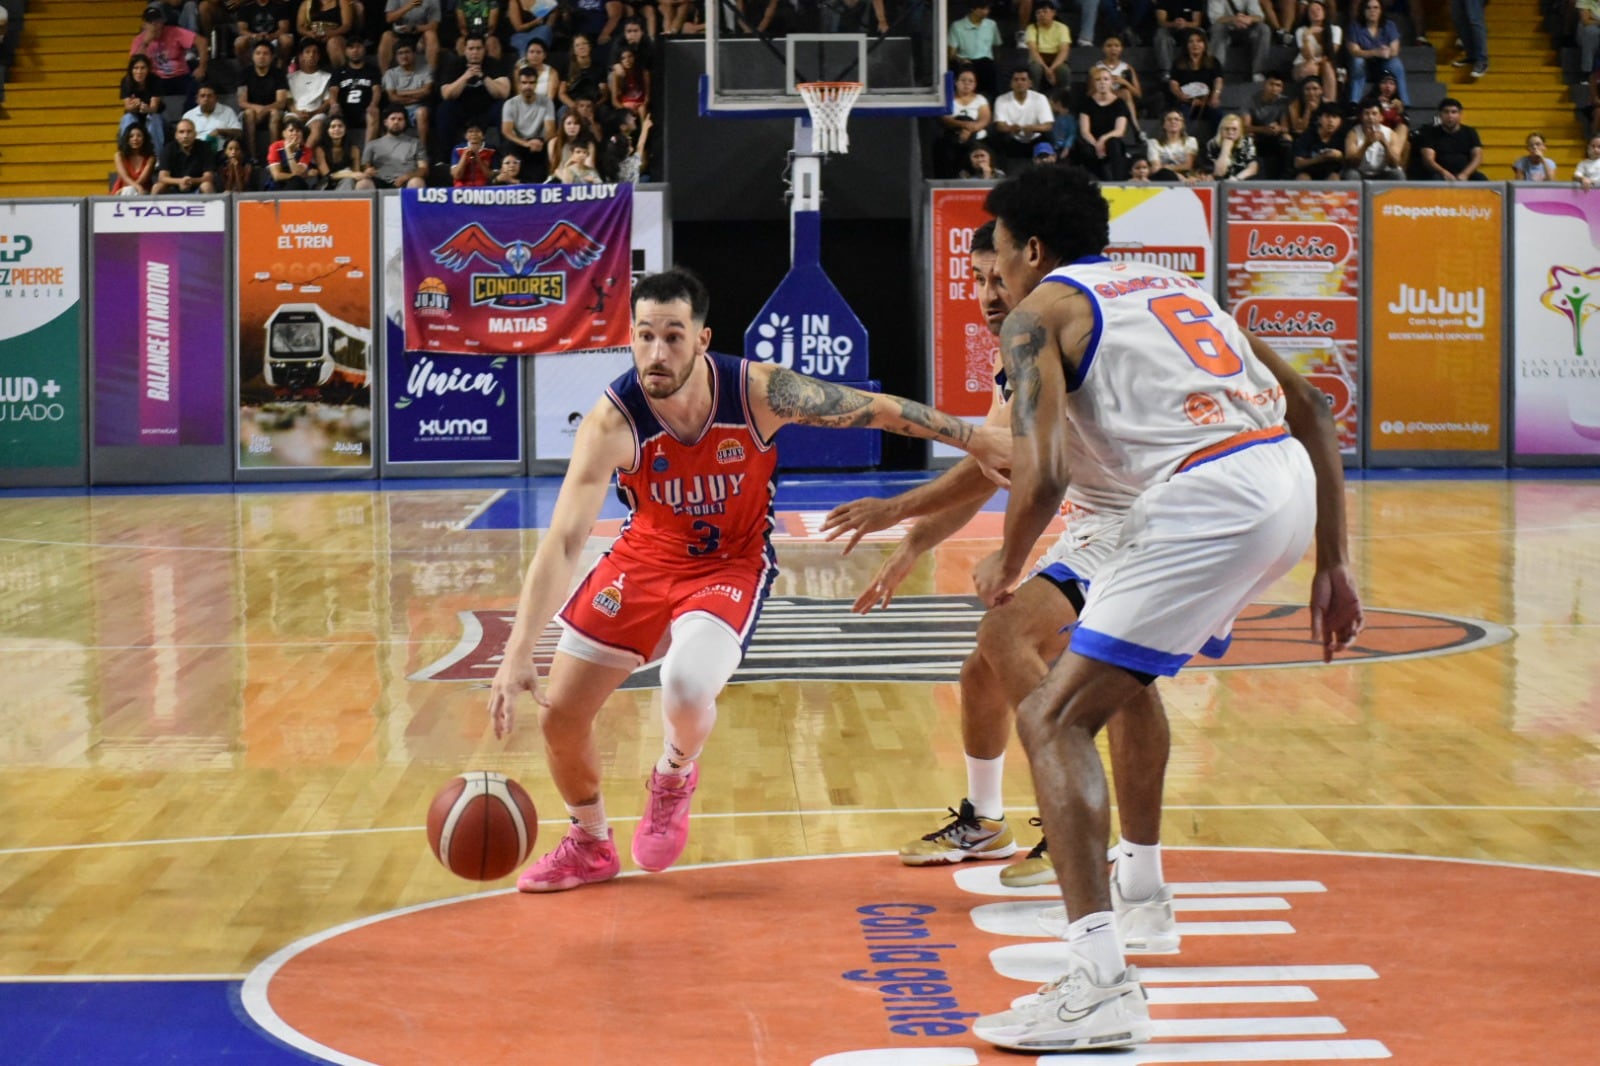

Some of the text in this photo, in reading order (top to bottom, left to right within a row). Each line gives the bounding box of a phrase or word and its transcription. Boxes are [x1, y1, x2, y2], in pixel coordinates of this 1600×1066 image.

[347, 89, 362, 103] 2
[418, 184, 618, 205] LOS CONDORES DE JUJUY
[129, 206, 205, 217] TADE
[1382, 205, 1492, 220] #DeportesJujuy
[281, 221, 328, 234] vuelve
[277, 235, 333, 249] EL TREN
[1248, 229, 1336, 259] Luisiño
[950, 257, 970, 279] DE
[147, 261, 170, 320] MOTION
[475, 276, 561, 298] CONDORES
[950, 282, 966, 300] DE
[415, 294, 449, 309] JUJUY
[147, 319, 170, 338] IN
[489, 317, 547, 333] MATIAS
[801, 314, 829, 335] IN
[1248, 305, 1336, 334] Luisiño
[801, 335, 853, 355] PRO
[1147, 293, 1243, 378] 6
[147, 337, 170, 401] BALANCE
[801, 355, 850, 375] JUY
[407, 356, 498, 398] Única
[11, 403, 64, 421] LADO
[419, 419, 487, 435] xuma
[650, 473, 745, 506] JUJUY
[687, 520, 720, 556] 3
[840, 903, 982, 1037] Con la gente
